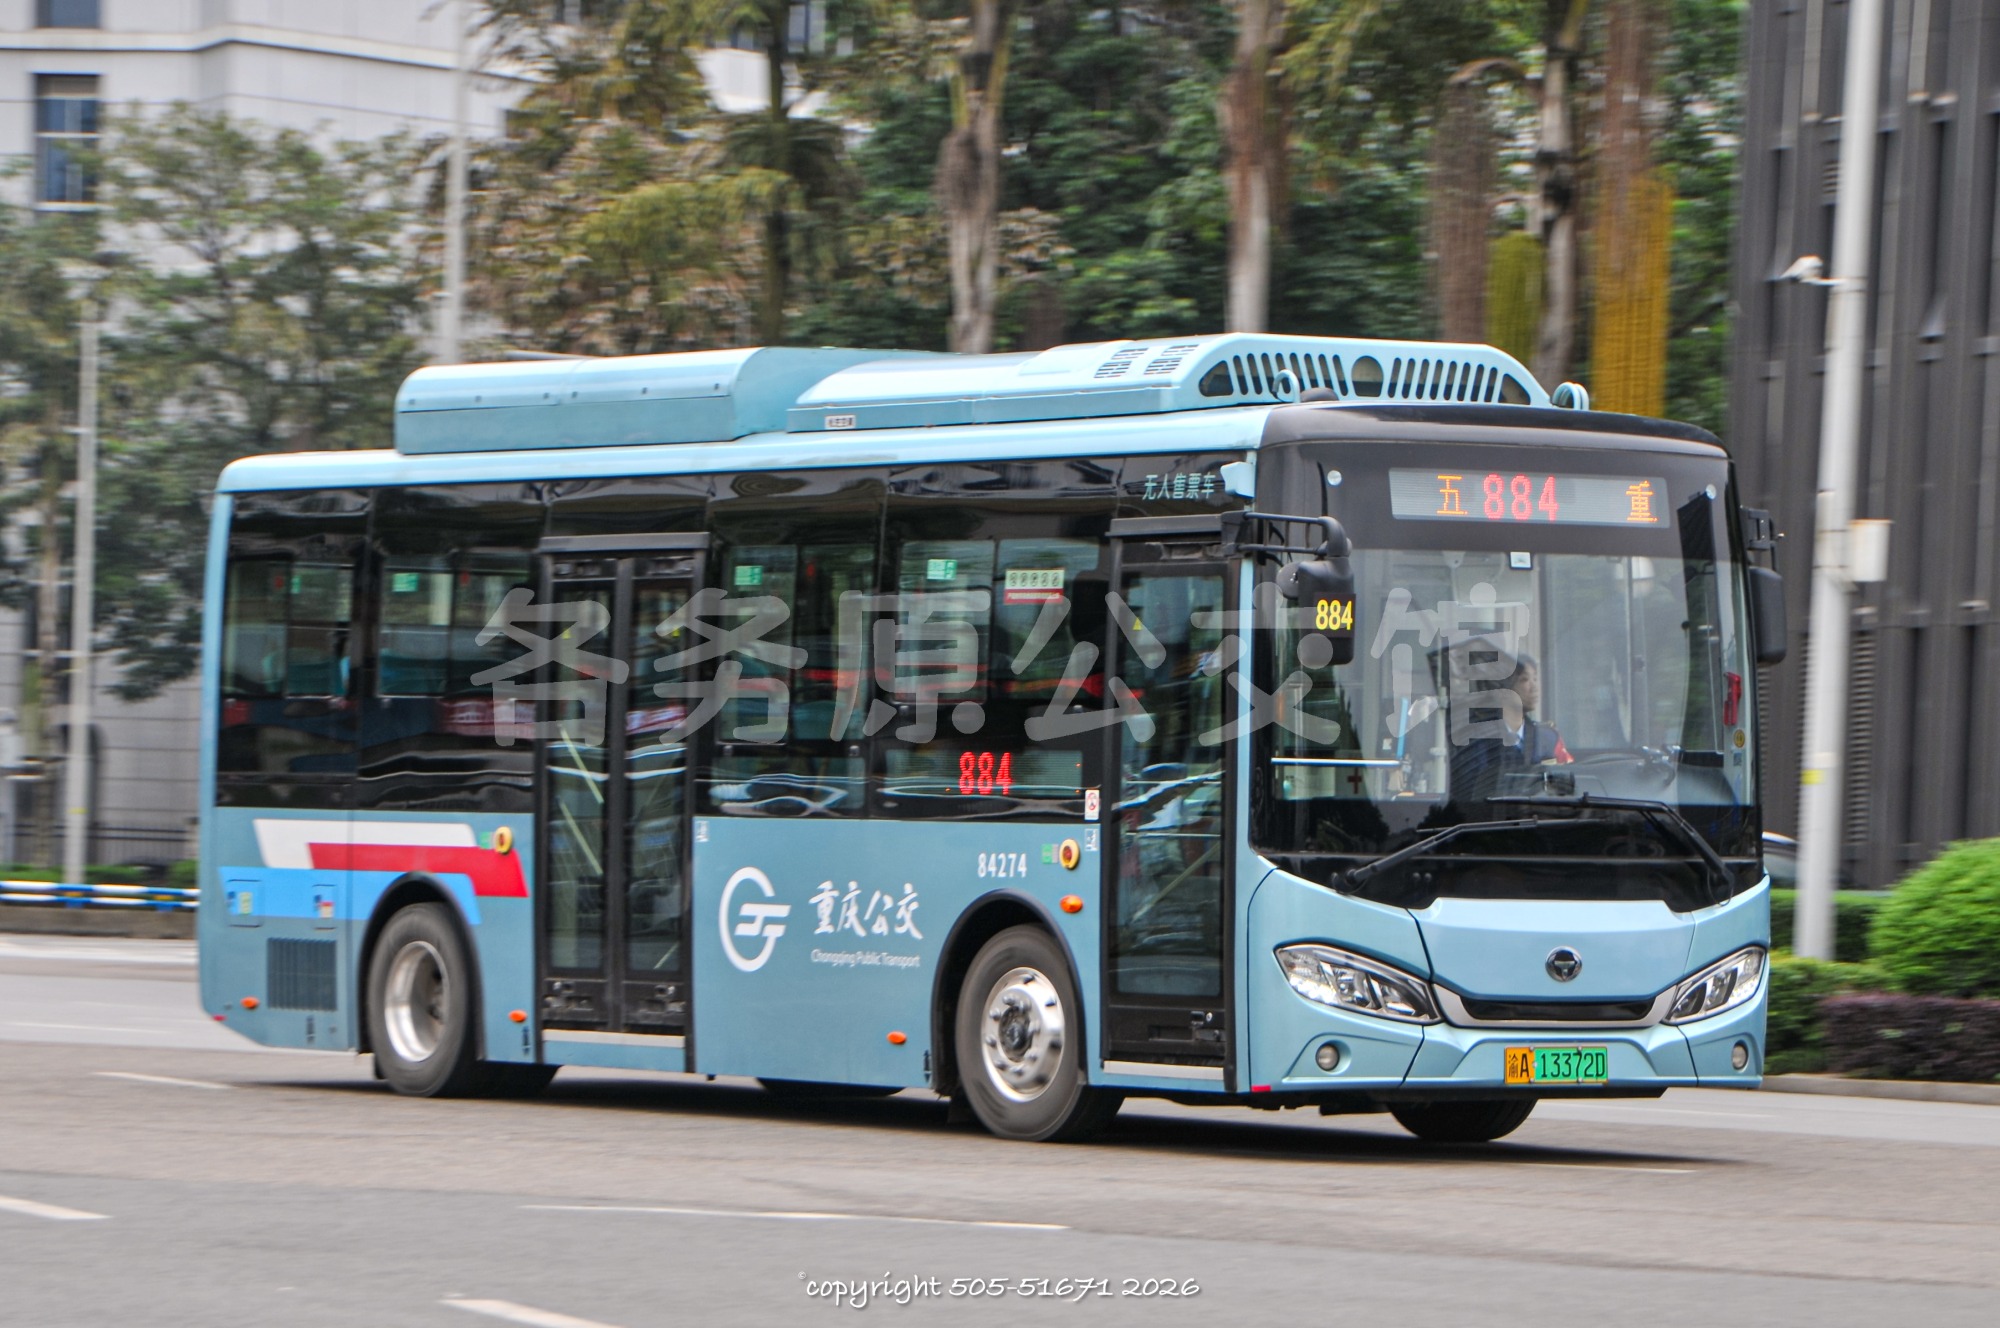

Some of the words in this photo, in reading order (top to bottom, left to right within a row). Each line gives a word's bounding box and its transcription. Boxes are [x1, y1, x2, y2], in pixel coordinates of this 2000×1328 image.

[1142, 472, 1216, 500] 无人售票车
[1437, 475, 1468, 514] 五
[1483, 474, 1559, 521] 884
[1626, 480, 1658, 522] 重
[1315, 599, 1353, 630] 884
[958, 751, 1012, 795] 884
[977, 852, 1027, 878] 84274
[808, 880, 923, 940] 重庆公交
[811, 949, 856, 968] Chongqing
[857, 951, 881, 966] Public
[881, 952, 920, 969] Transport
